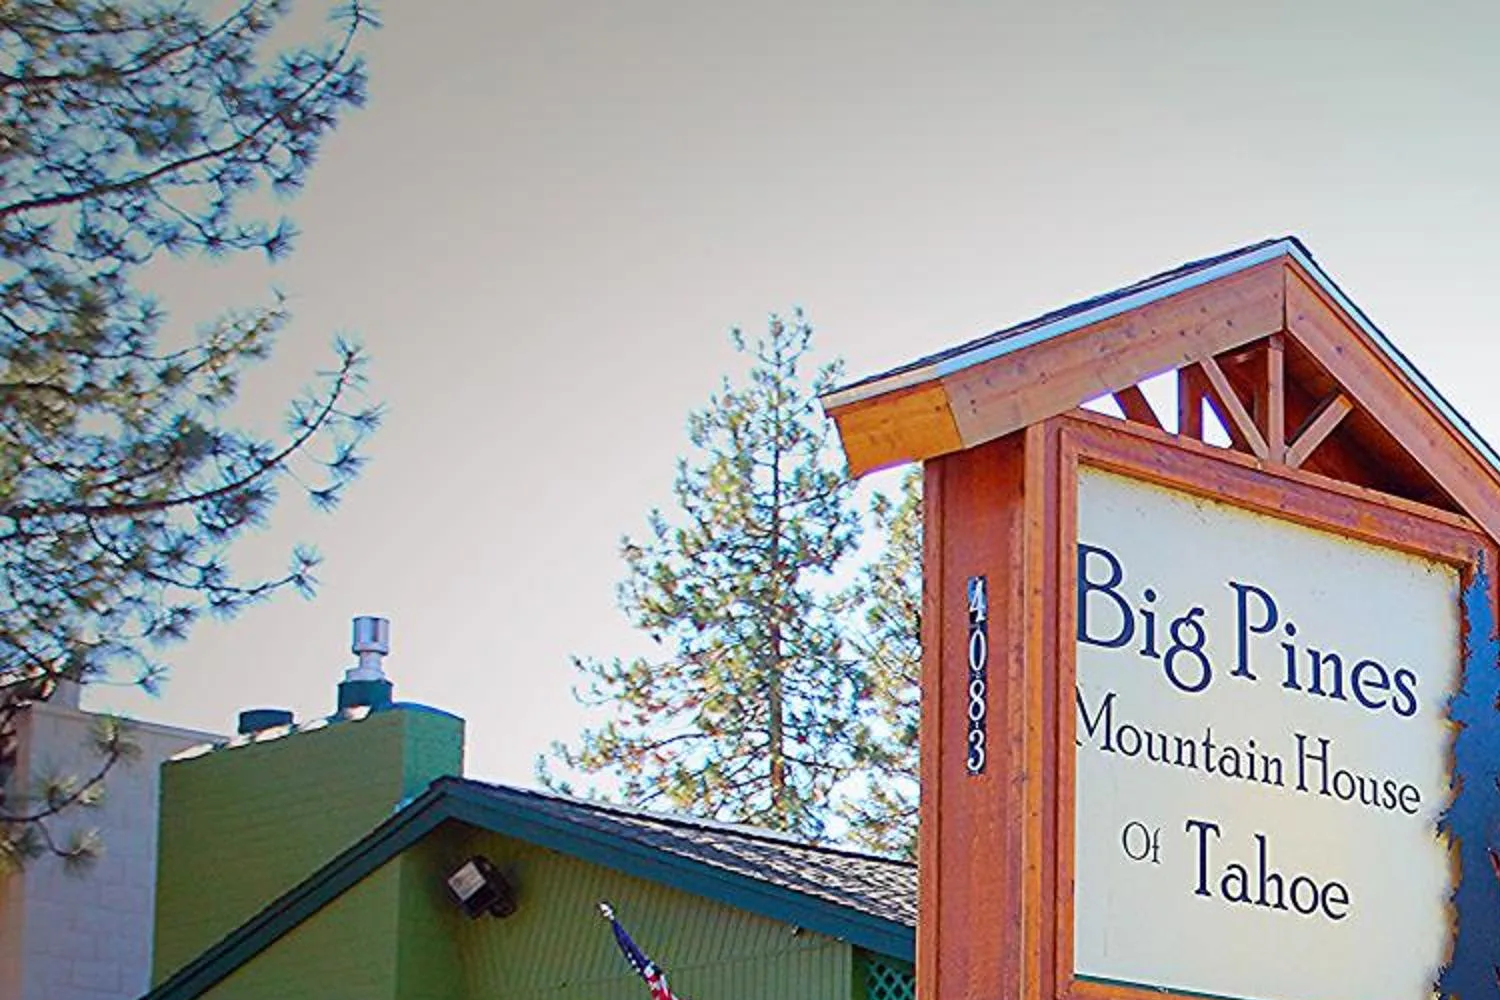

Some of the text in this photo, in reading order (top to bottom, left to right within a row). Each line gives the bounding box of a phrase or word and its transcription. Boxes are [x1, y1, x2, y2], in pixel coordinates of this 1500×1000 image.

[967, 579, 987, 772] 4083
[1076, 542, 1418, 718] Big Pines
[1075, 686, 1422, 815] Mountain House
[1122, 818, 1351, 921] Of Tahoe
